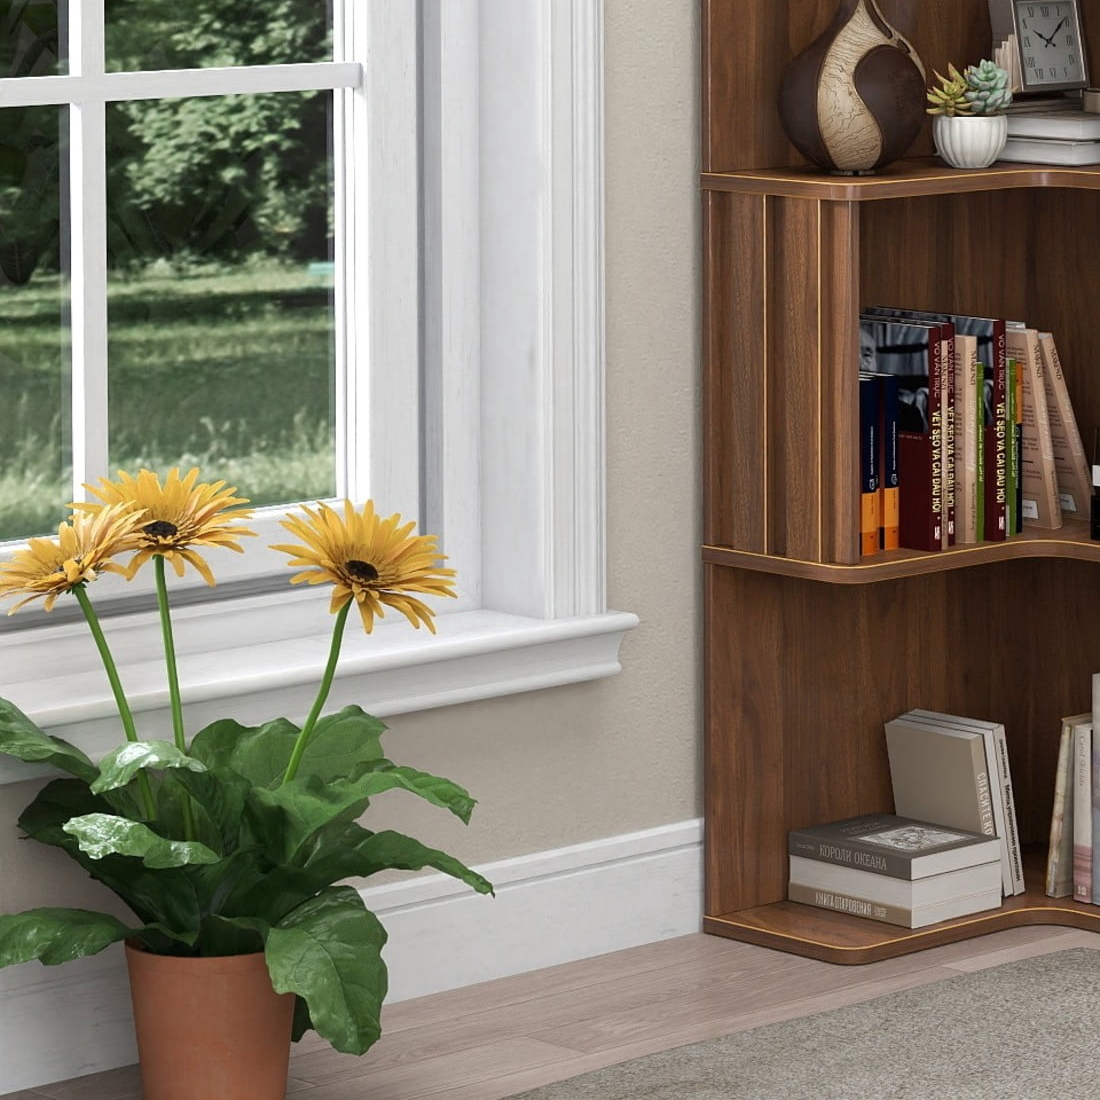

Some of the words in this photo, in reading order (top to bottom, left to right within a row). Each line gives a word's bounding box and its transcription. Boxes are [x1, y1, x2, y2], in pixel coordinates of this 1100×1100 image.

[976, 771, 992, 819] СПАСИТЕ
[819, 843, 852, 863] КОРОЛИ
[854, 851, 887, 872] ОКЕАНА
